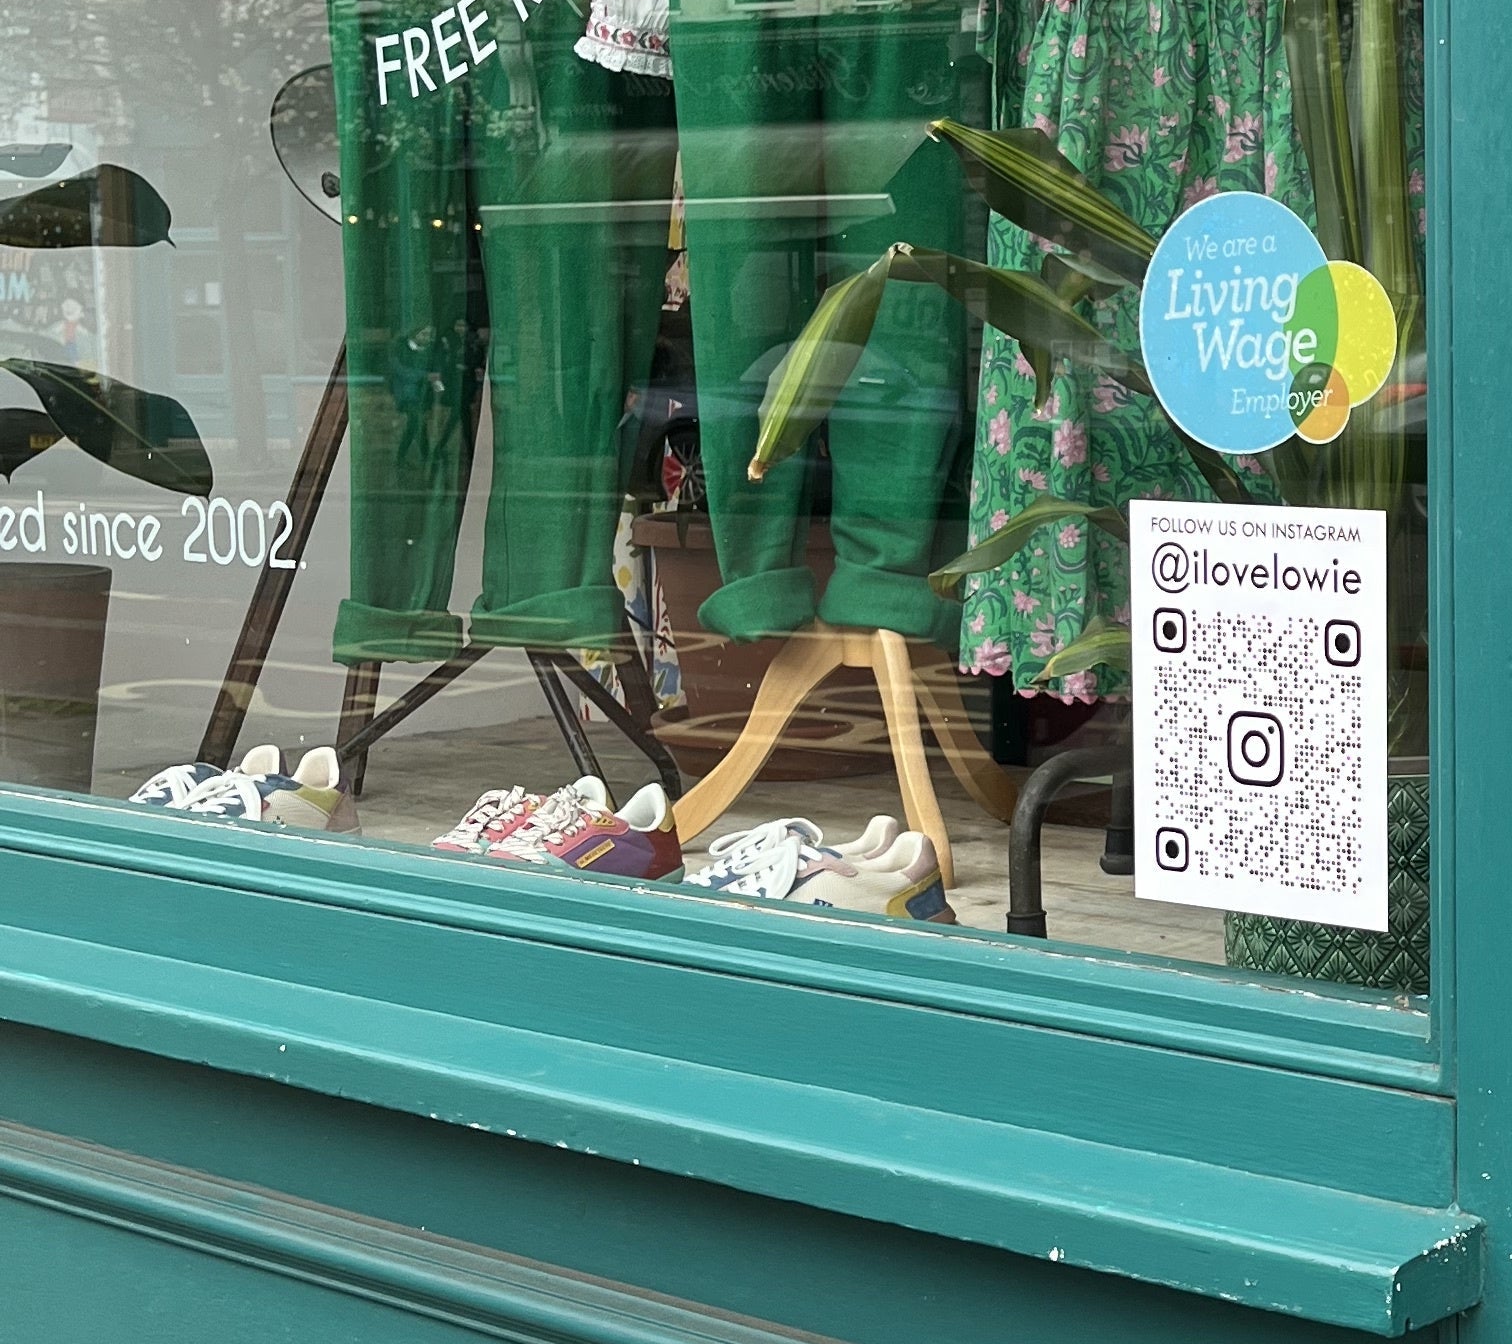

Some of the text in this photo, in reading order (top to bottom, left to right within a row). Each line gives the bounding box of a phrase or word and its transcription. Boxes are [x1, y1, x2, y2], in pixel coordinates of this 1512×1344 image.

[1185, 234, 1277, 262] We are a
[1163, 265, 1299, 324] Living
[1192, 318, 1318, 381] Wage
[1230, 382, 1334, 420] Employer
[62, 502, 163, 562] since
[181, 496, 307, 570] 2002.
[1151, 517, 1362, 543] FOLLOW US ON INSTAGRAM
[1151, 541, 1362, 595] @ilovelowie
